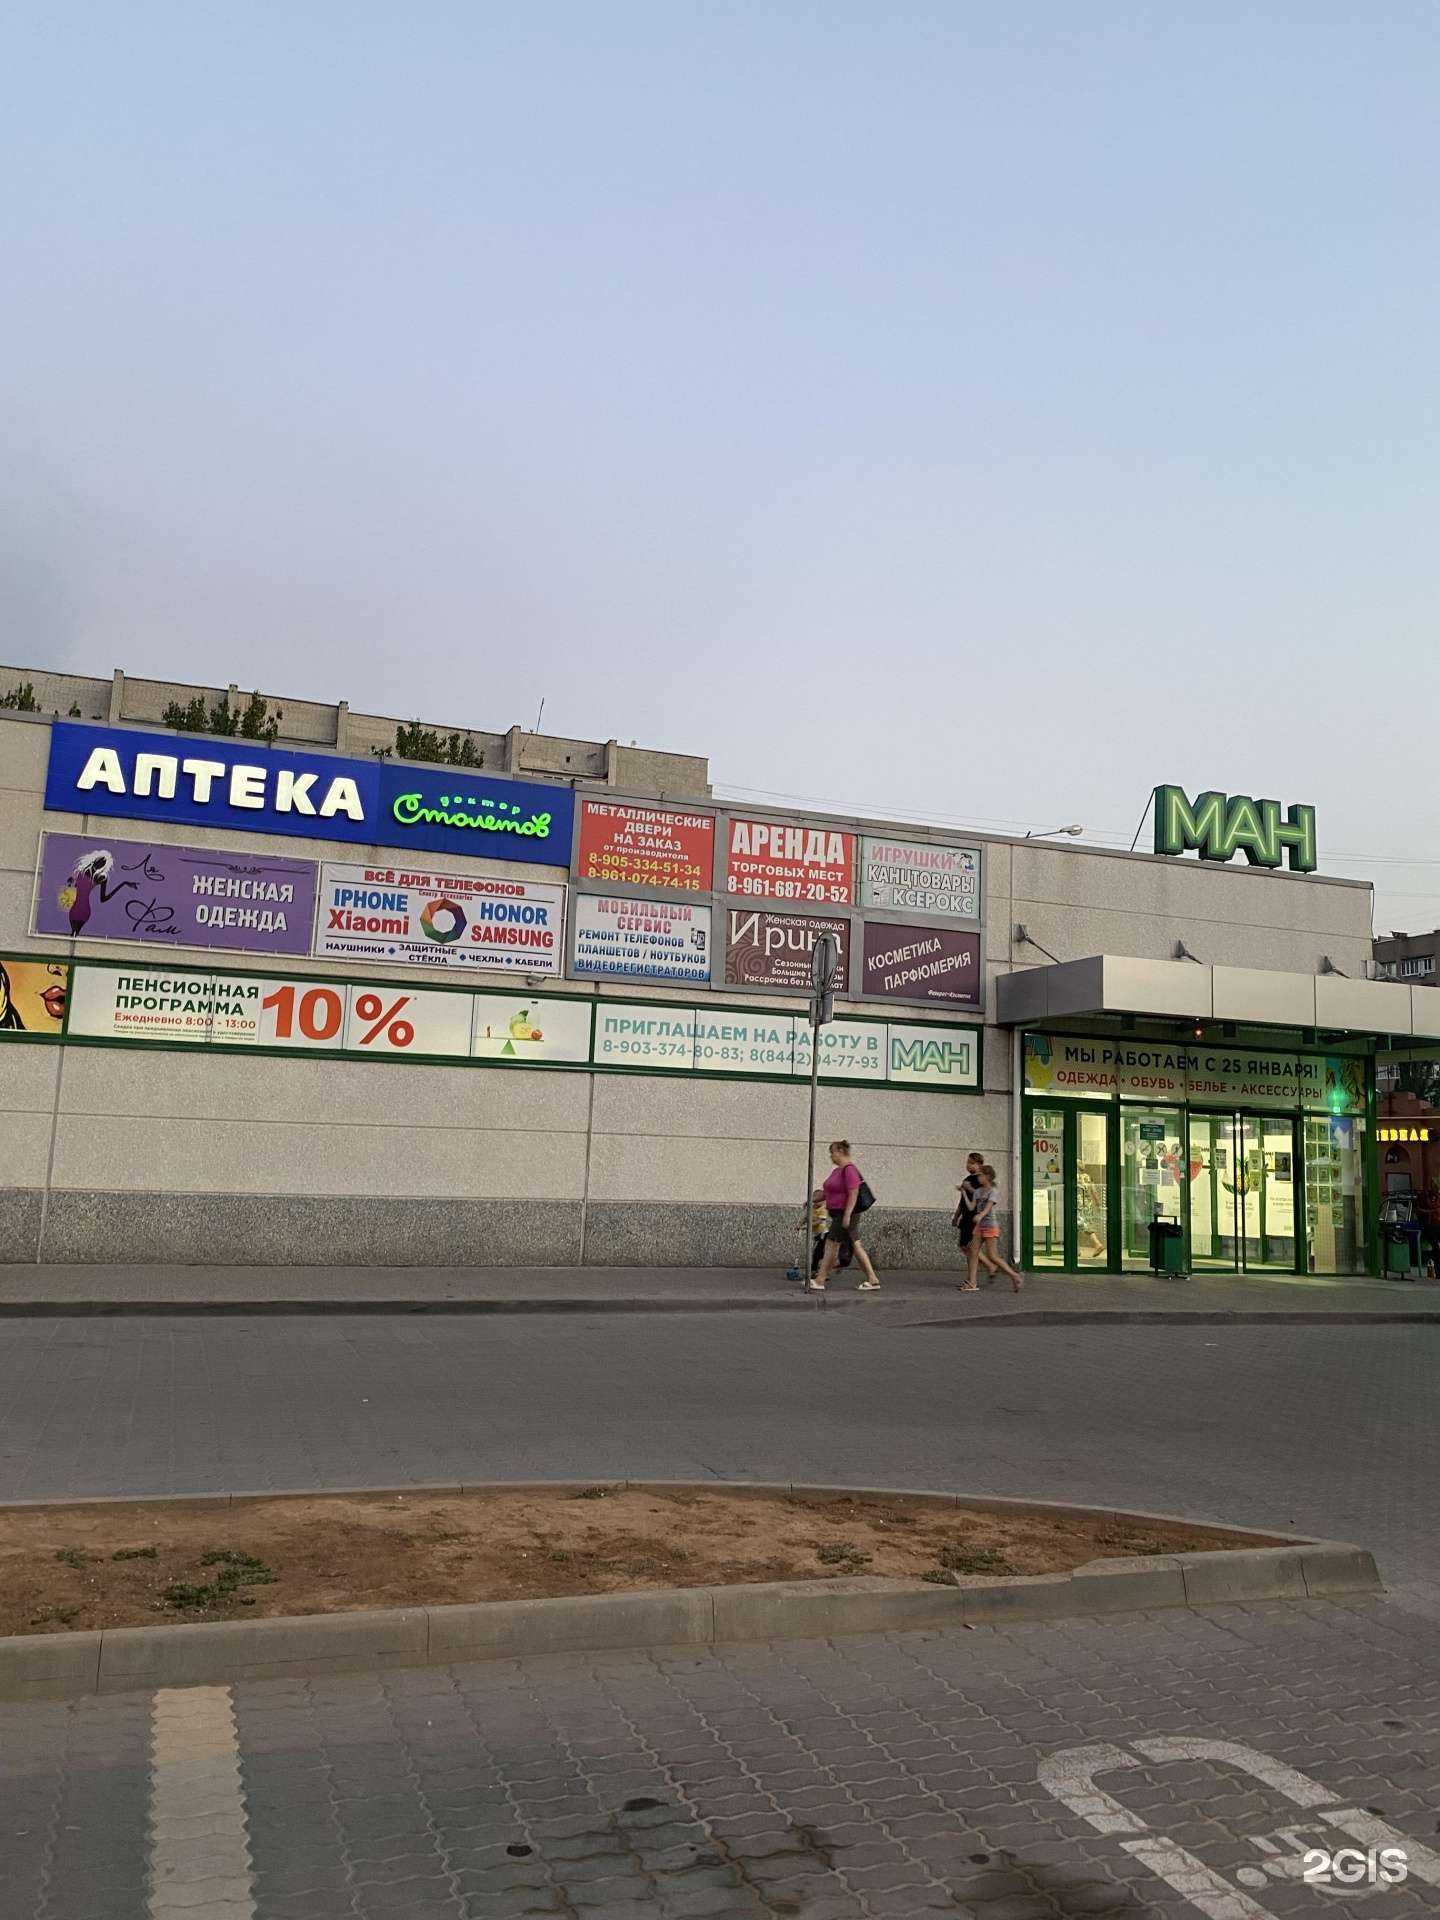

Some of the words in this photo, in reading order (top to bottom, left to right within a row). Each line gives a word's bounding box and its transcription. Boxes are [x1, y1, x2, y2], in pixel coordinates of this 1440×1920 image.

[76, 747, 364, 821] АПТЕКА
[393, 793, 551, 838] Столетов
[440, 796, 520, 815] доктор
[587, 803, 711, 830] МЕТАЛЛИЧЕСКИЕ
[624, 822, 672, 837] ДВЕРИ
[1154, 784, 1317, 872] МАН
[613, 833, 633, 845] НА
[638, 837, 681, 851] ЗАКАЗ
[617, 846, 689, 861] производителя
[731, 822, 845, 868] АРЕНДА
[588, 852, 701, 877] 8-905-334-51-34
[871, 845, 952, 870] ИГРУШКИ
[364, 870, 395, 884] ВСЁ
[398, 874, 430, 887] ДЛЯ
[435, 877, 525, 896] ТЕЛЕФОНОВ
[587, 866, 700, 890] 8-961-074-74-15
[732, 861, 805, 878] ТОРГОВЫХ
[808, 869, 844, 882] МЕСТ
[867, 864, 975, 894] КАНЦТОВАРЫ
[192, 874, 294, 903] ЖЕНСКАЯ
[334, 888, 408, 912] IPHONE
[727, 875, 848, 903] 8-961-687-20-52
[893, 887, 973, 913] КСЕРОКС
[195, 904, 288, 933] ОДЕЖДА
[327, 908, 409, 935] Xiaomi
[480, 901, 547, 925] HONOR
[597, 899, 692, 921] МОБИЛЬНЫЙ
[617, 916, 672, 934] СЕРВИС
[765, 914, 807, 927] Женская
[809, 920, 845, 931] одежда
[325, 942, 385, 954] НАУШНИКИ
[471, 924, 553, 948] SAMSUNG
[579, 928, 619, 941] РЕМОНТ
[623, 933, 684, 948] ТЕЛЕФОНОВ
[399, 944, 457, 955] ЗАЩИТНЫЕ
[468, 954, 503, 963] ЧЕХЛЫ
[577, 943, 640, 959] ПЛАНШЕТОВ
[650, 950, 706, 964] НОУТБУКОВ
[868, 937, 942, 971] КОСМЕТИКА
[515, 958, 552, 968] КАБЕЛИ
[578, 958, 705, 979] ВИДЕОРЕГИСТРАТОРОВ
[884, 951, 971, 990] ПАРФЮМЕРИЯ
[117, 977, 259, 999] ПЕНСИОННАЯ
[115, 995, 244, 1016] ПРОГРАММА
[114, 1012, 182, 1025] Ежедневно
[185, 1016, 213, 1026] 8:00
[225, 1019, 256, 1029] 13:00
[604, 1017, 747, 1042] ПРИГЛАШАЕМ
[753, 1028, 780, 1044] НА
[866, 1036, 878, 1050] В
[891, 1038, 970, 1075] МАН
[1065, 1046, 1095, 1063] МЫ
[1102, 1049, 1198, 1070] РАБОТАЕМ
[1205, 1057, 1215, 1072] С
[1222, 1058, 1241, 1073] 25
[1247, 1061, 1318, 1079] ЯНВАРЯ!
[1056, 1070, 1118, 1087] ОДЕЖДА
[1130, 1076, 1175, 1090] ОБУВЬ
